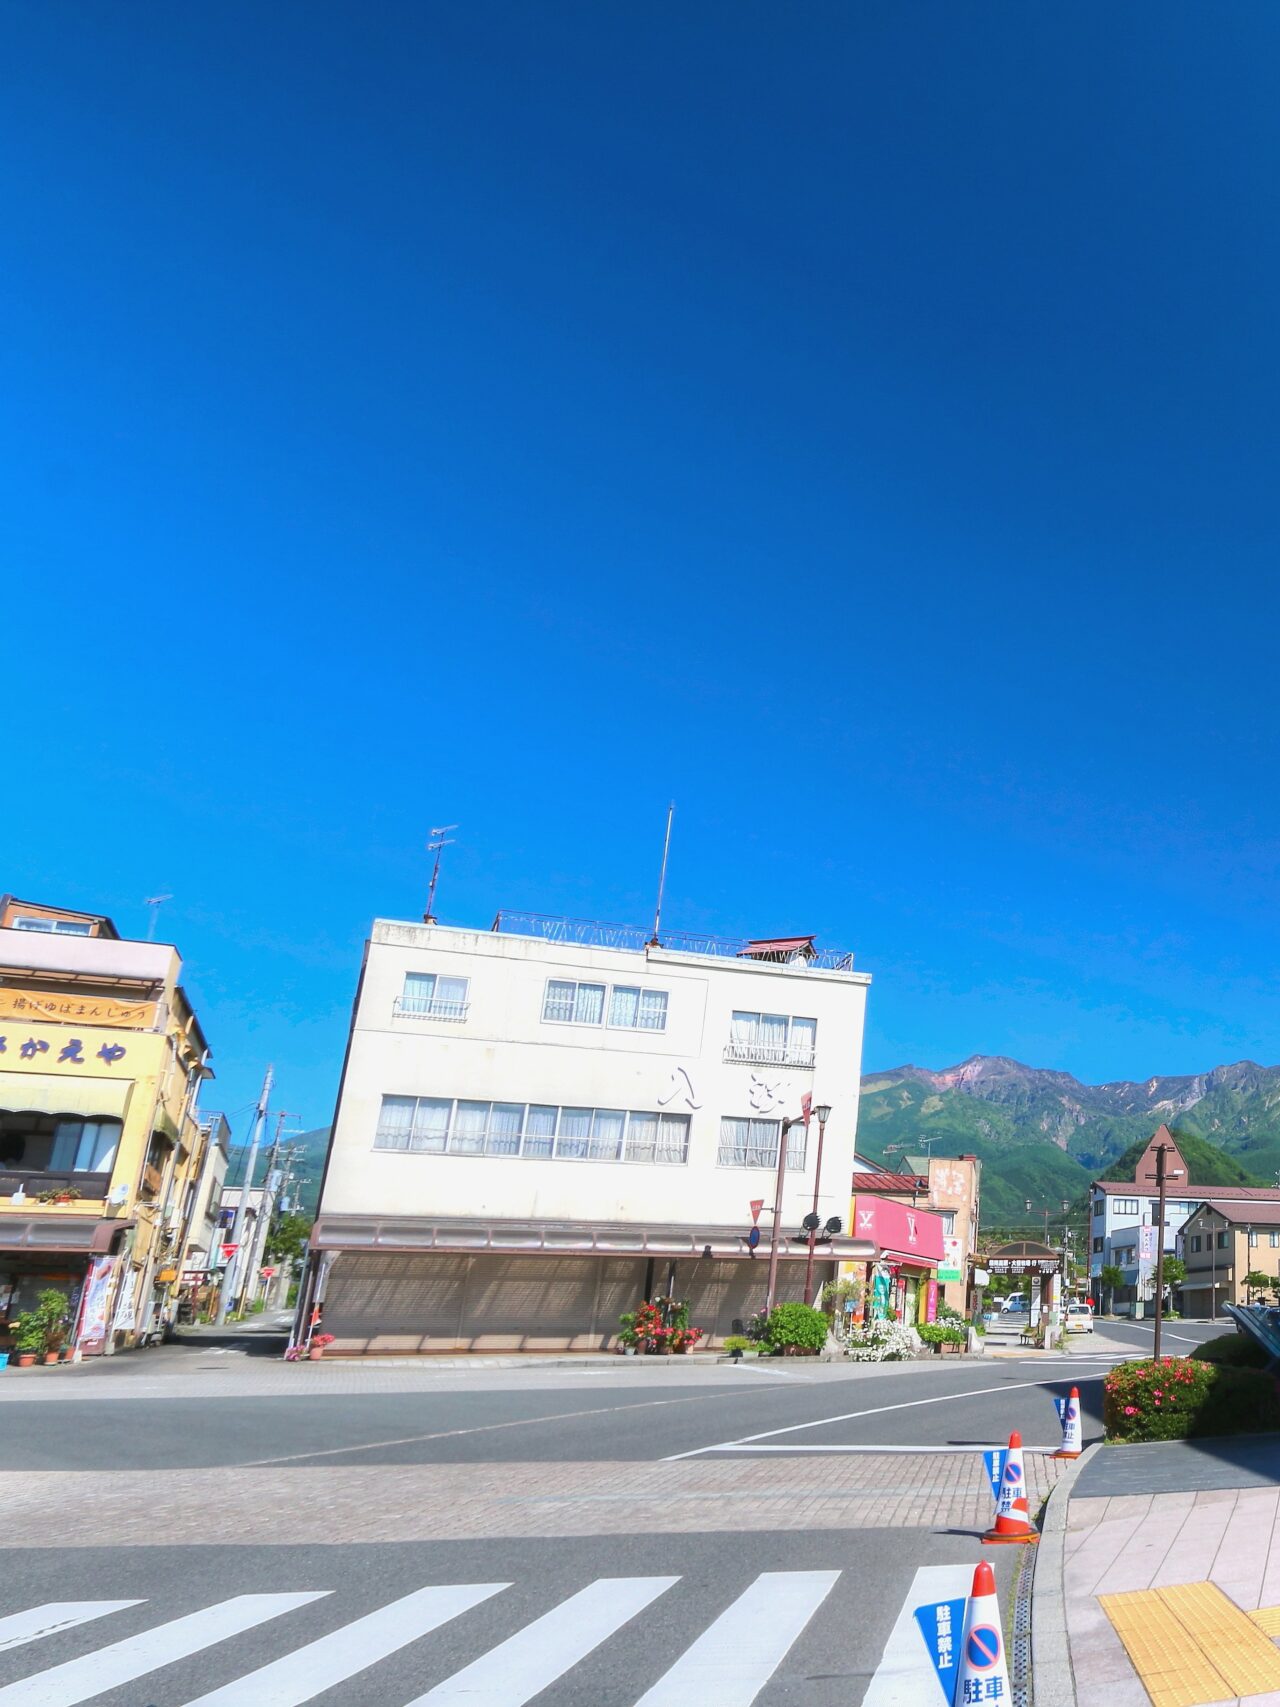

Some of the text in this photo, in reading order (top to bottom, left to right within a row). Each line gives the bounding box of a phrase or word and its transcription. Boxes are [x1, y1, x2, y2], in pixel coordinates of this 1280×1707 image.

[992, 1452, 1000, 1483] 駐車禁止
[1001, 1487, 1023, 1499] 駐車
[936, 1604, 953, 1669] 駐車禁止
[962, 1676, 1004, 1705] 駐車
